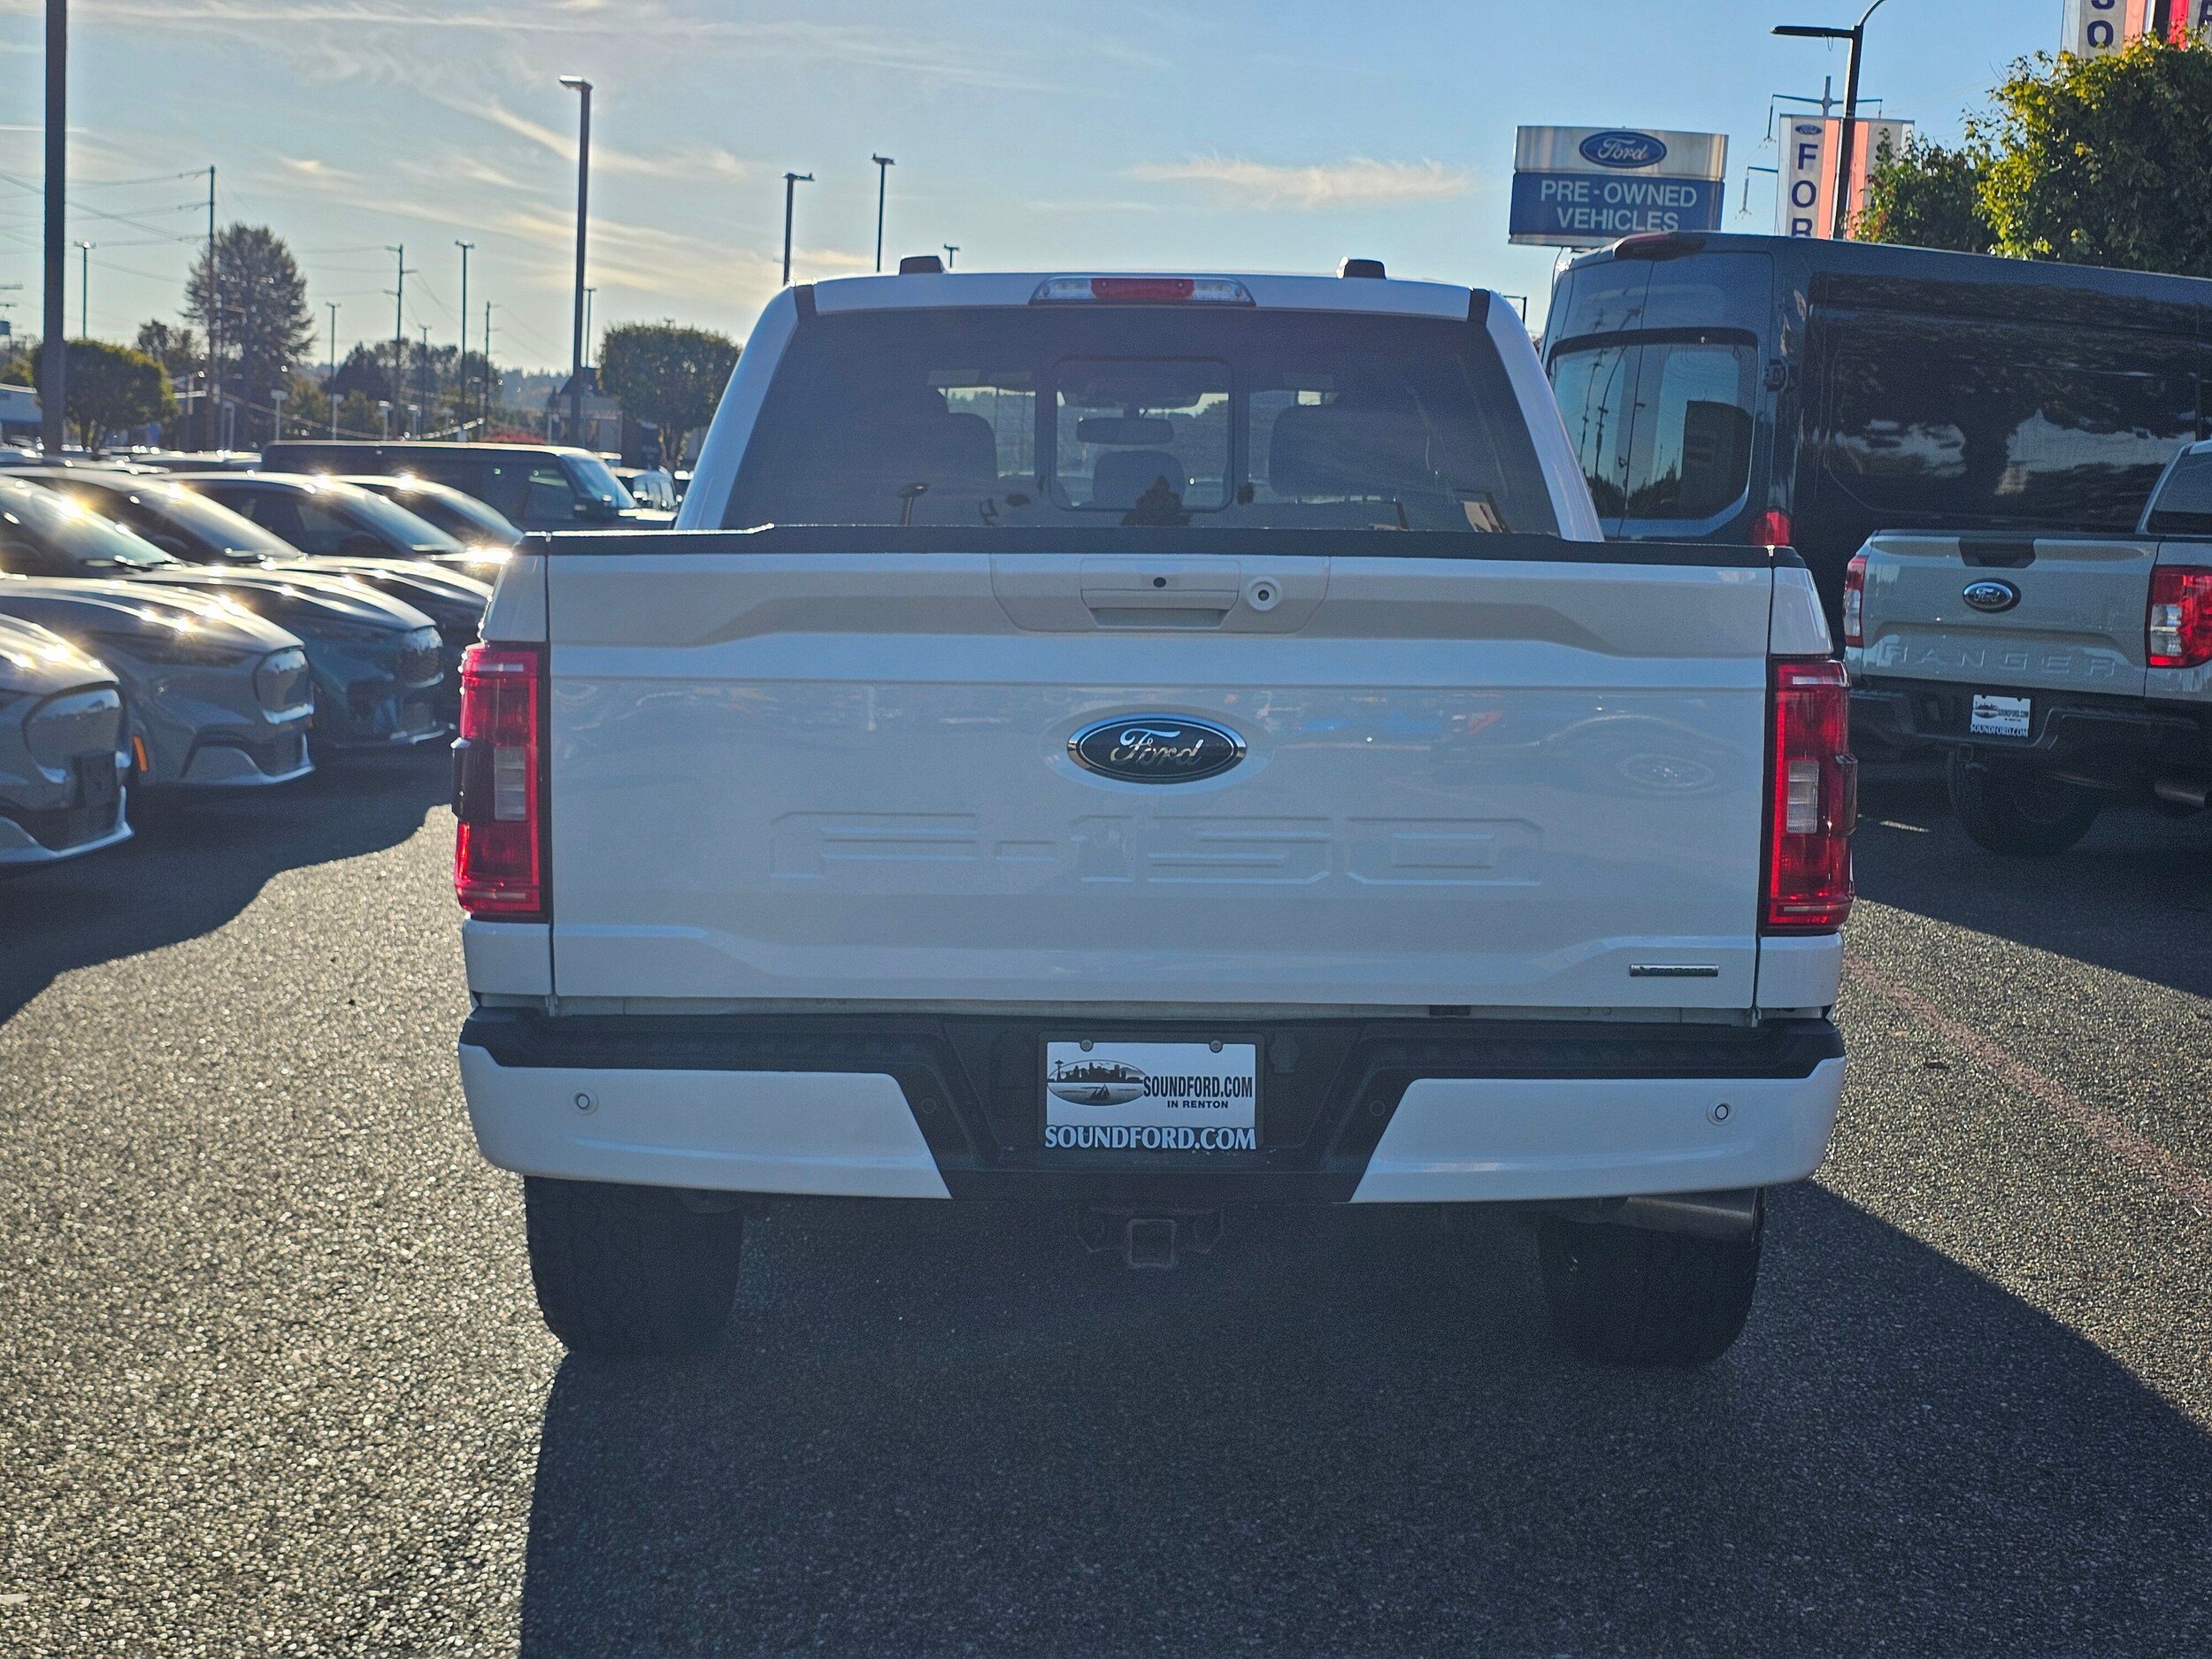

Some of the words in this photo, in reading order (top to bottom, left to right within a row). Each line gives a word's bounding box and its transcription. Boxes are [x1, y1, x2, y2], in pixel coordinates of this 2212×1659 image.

[1556, 206, 1679, 232] VEHICLES
[1881, 643, 2116, 678] RANGER
[1110, 728, 1204, 766] Ford
[769, 810, 1543, 885] F-150
[1143, 1075, 1253, 1098] SOUNDFORD.COM
[1167, 1100, 1179, 1109] IN
[1182, 1100, 1229, 1109] RENTON
[1045, 1125, 1256, 1150] SOUNDFORD.COM
